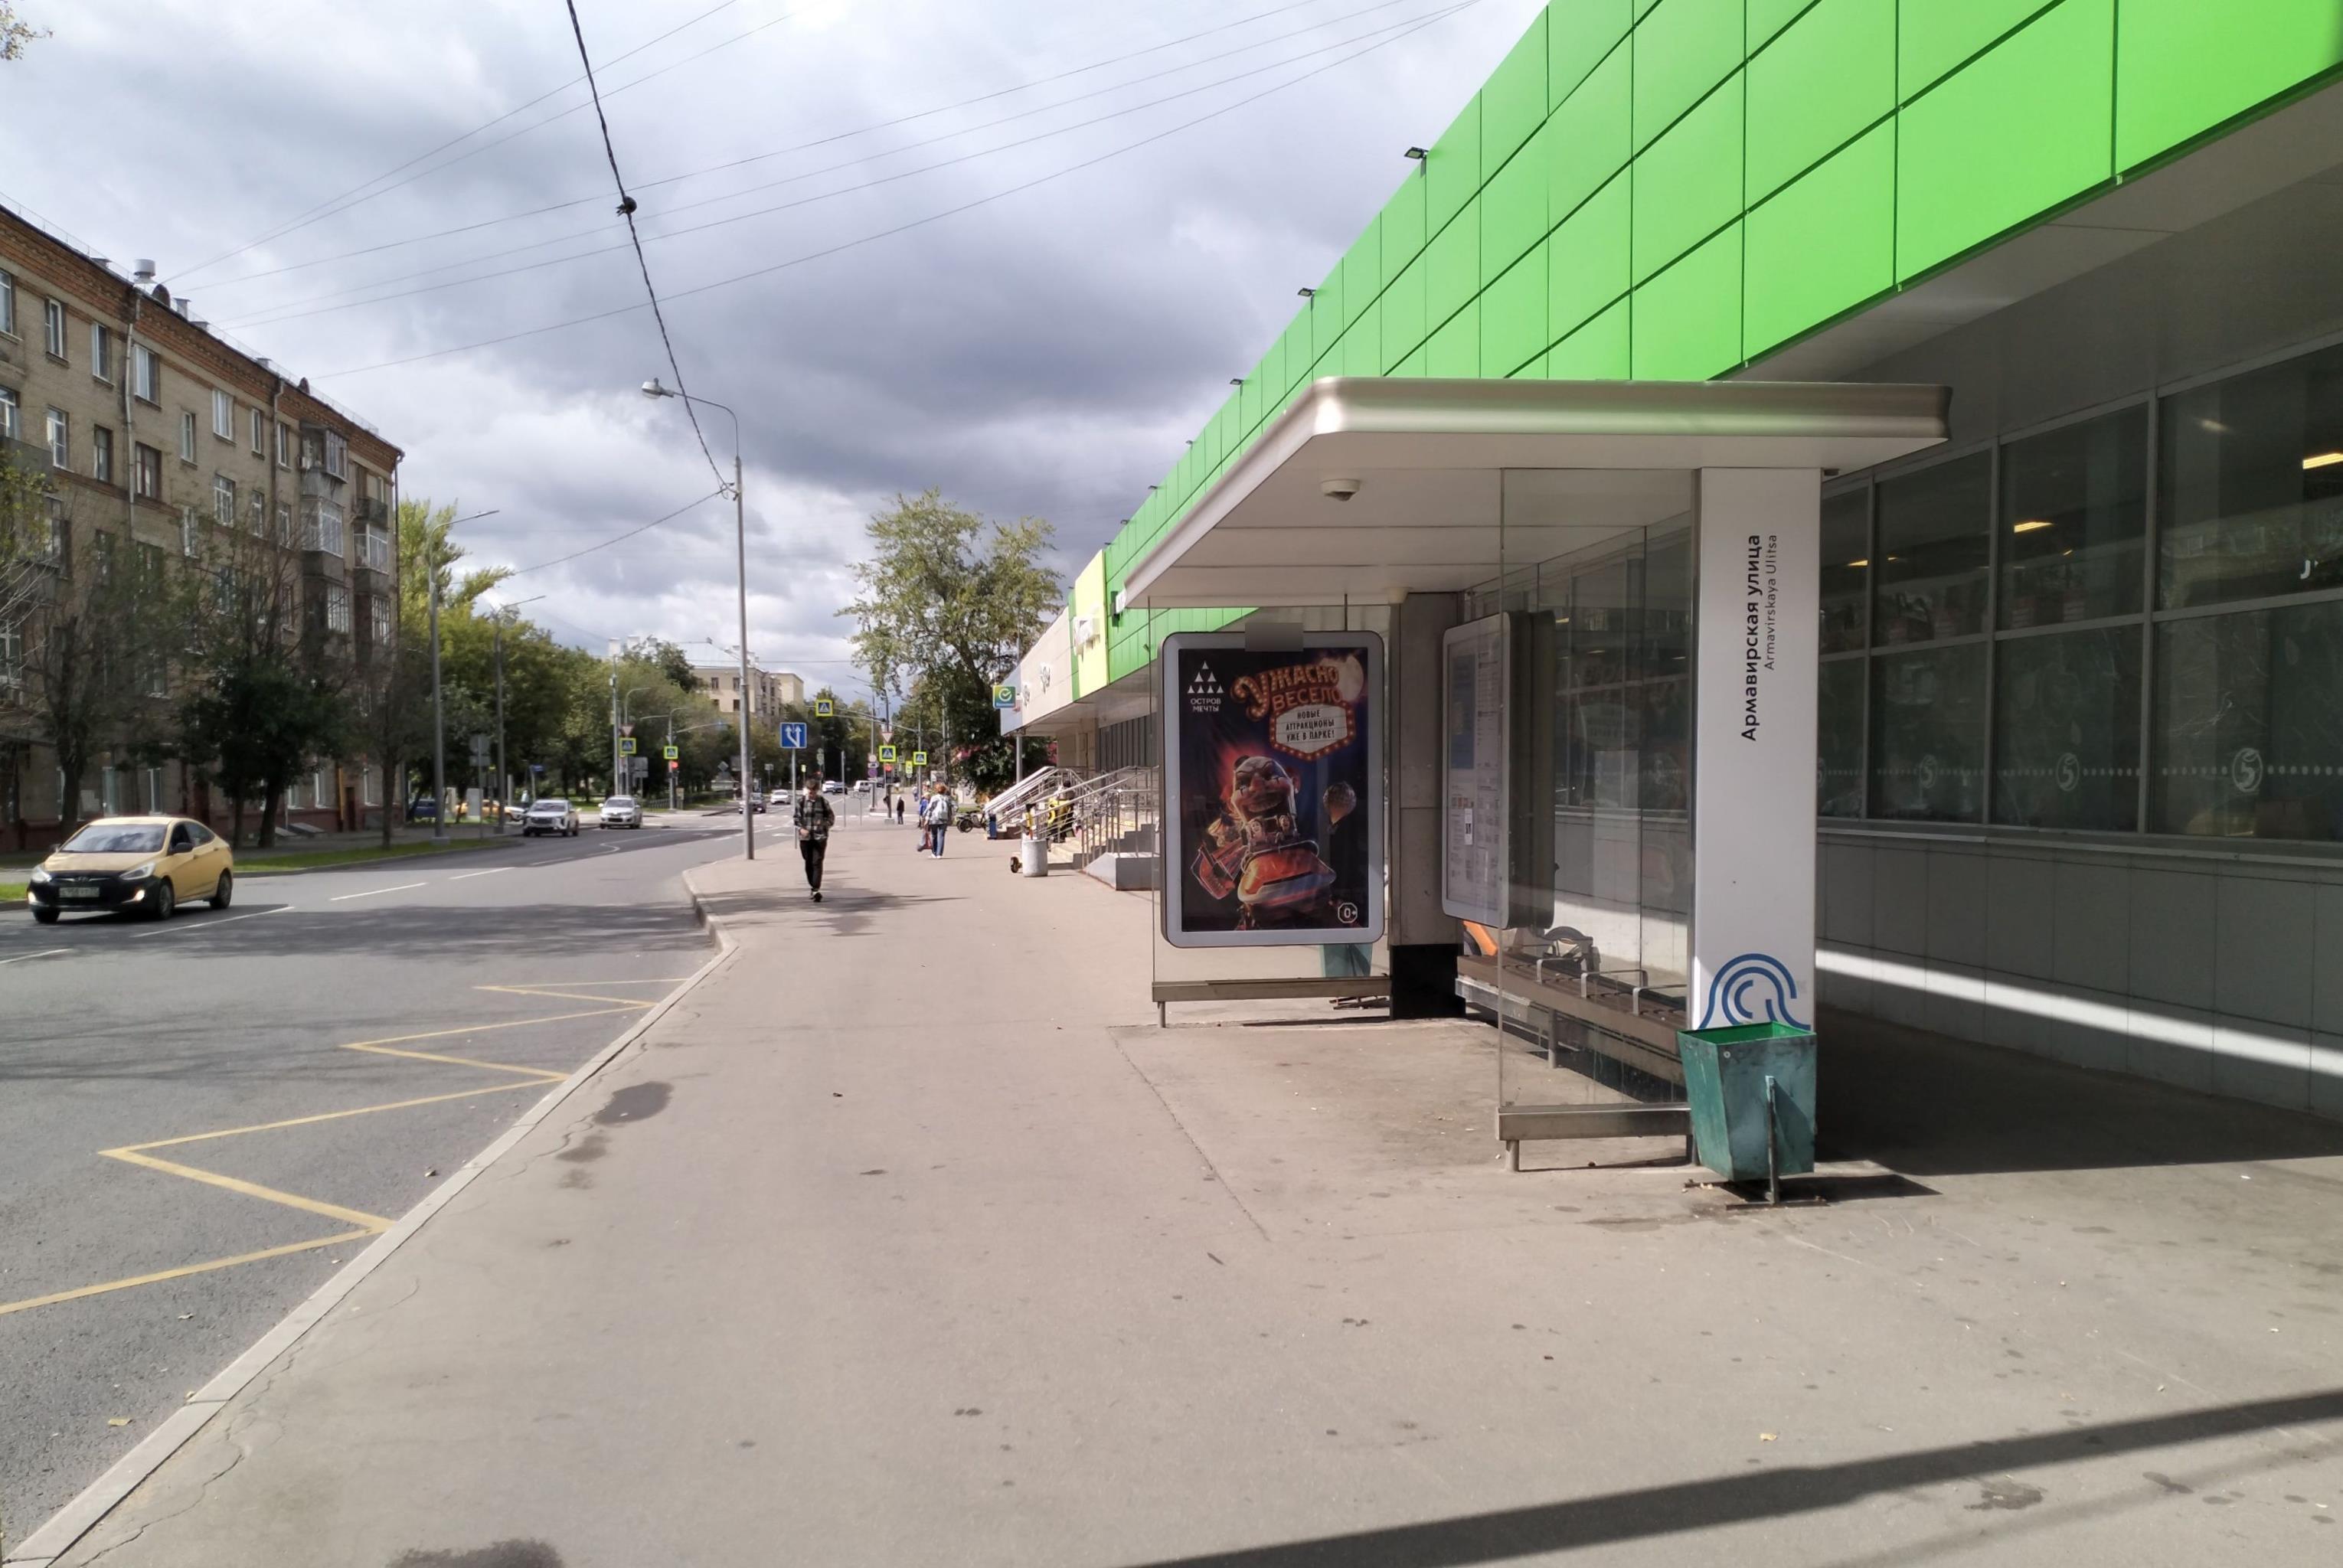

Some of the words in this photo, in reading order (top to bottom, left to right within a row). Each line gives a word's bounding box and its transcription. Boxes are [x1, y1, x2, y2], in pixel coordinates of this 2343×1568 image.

[1747, 535, 1763, 596] улица
[1765, 535, 1776, 574] Ulitsa
[1764, 579, 1778, 670] Armavirskaya
[1741, 603, 1761, 741] Армавирская
[1231, 665, 1339, 720] УЖАСНО
[1272, 688, 1341, 711] ВЕСЕЛО
[1286, 720, 1335, 730] АТТРАКЦИОНЫ
[1297, 710, 1320, 719] НОВЫЕ
[1287, 733, 1299, 742] УЖЕ
[1302, 732, 1306, 740] В
[1309, 730, 1334, 739] ПАРКЕ!
